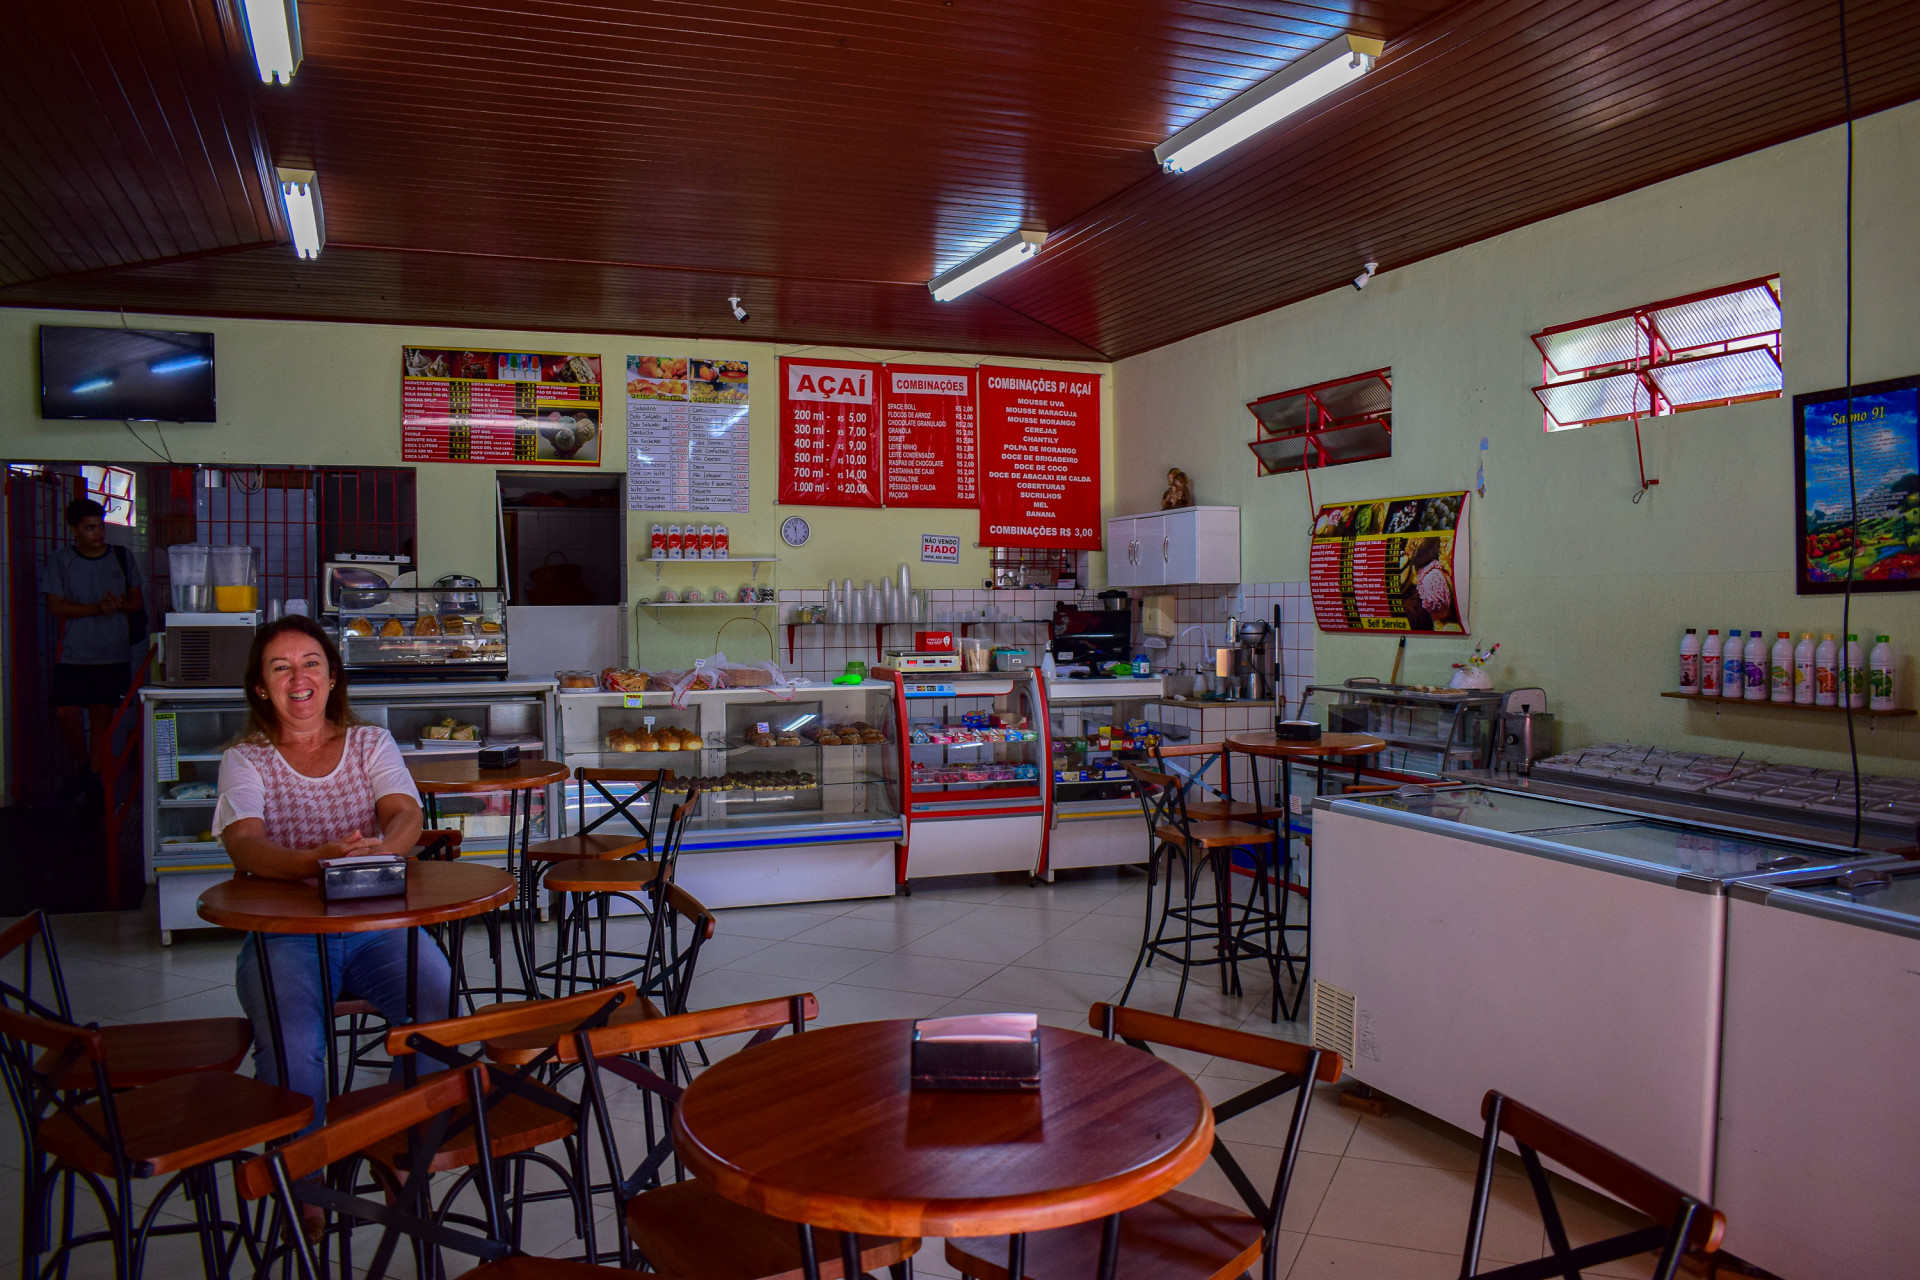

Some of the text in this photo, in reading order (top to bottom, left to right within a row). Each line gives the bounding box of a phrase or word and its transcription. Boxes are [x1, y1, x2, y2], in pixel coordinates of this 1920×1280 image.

[796, 374, 866, 399] AÇAÍ
[897, 380, 964, 393] COMBINAÇÕES
[988, 377, 1091, 397] COMBINAÇÕES P/ AÇAÍ
[1018, 398, 1065, 408] MOUSSE UVA
[794, 410, 811, 420] 200
[813, 411, 824, 420] ml
[849, 413, 866, 423] 5,00
[1006, 407, 1077, 418] MOUSSE MARACUJA
[1832, 406, 1885, 426] Samo 91
[1040, 419, 1076, 427] MORANGO
[794, 424, 811, 434] 300
[813, 425, 824, 435] ml
[849, 427, 866, 437] 7,00
[1025, 427, 1057, 435] CEREJAS
[794, 439, 811, 448] 400
[813, 440, 824, 449] ml
[849, 441, 866, 451] 9,00
[1023, 436, 1059, 444] CHANTILY
[1004, 444, 1028, 452] POLPA
[1041, 446, 1077, 454] MORANGO
[794, 453, 810, 462] 500
[812, 454, 824, 463] ml
[846, 455, 867, 465] 10,00
[1035, 455, 1078, 464] BRIGADEIRO
[794, 468, 810, 477] 700
[812, 469, 824, 478] ml
[845, 470, 867, 480] 14,00
[1023, 473, 1054, 481] ABACAXI
[1069, 475, 1091, 483] CALDA
[794, 482, 813, 492] 1.000
[815, 483, 824, 492] ml
[845, 484, 867, 494] 20,00
[1017, 482, 1065, 491] COBERTURAS
[1020, 492, 1062, 500] SUCRILHOS
[990, 525, 1093, 538] COMBINAÇÕES R$ 3,00
[924, 545, 956, 554] FIADO
[1368, 619, 1407, 629] Self Service
